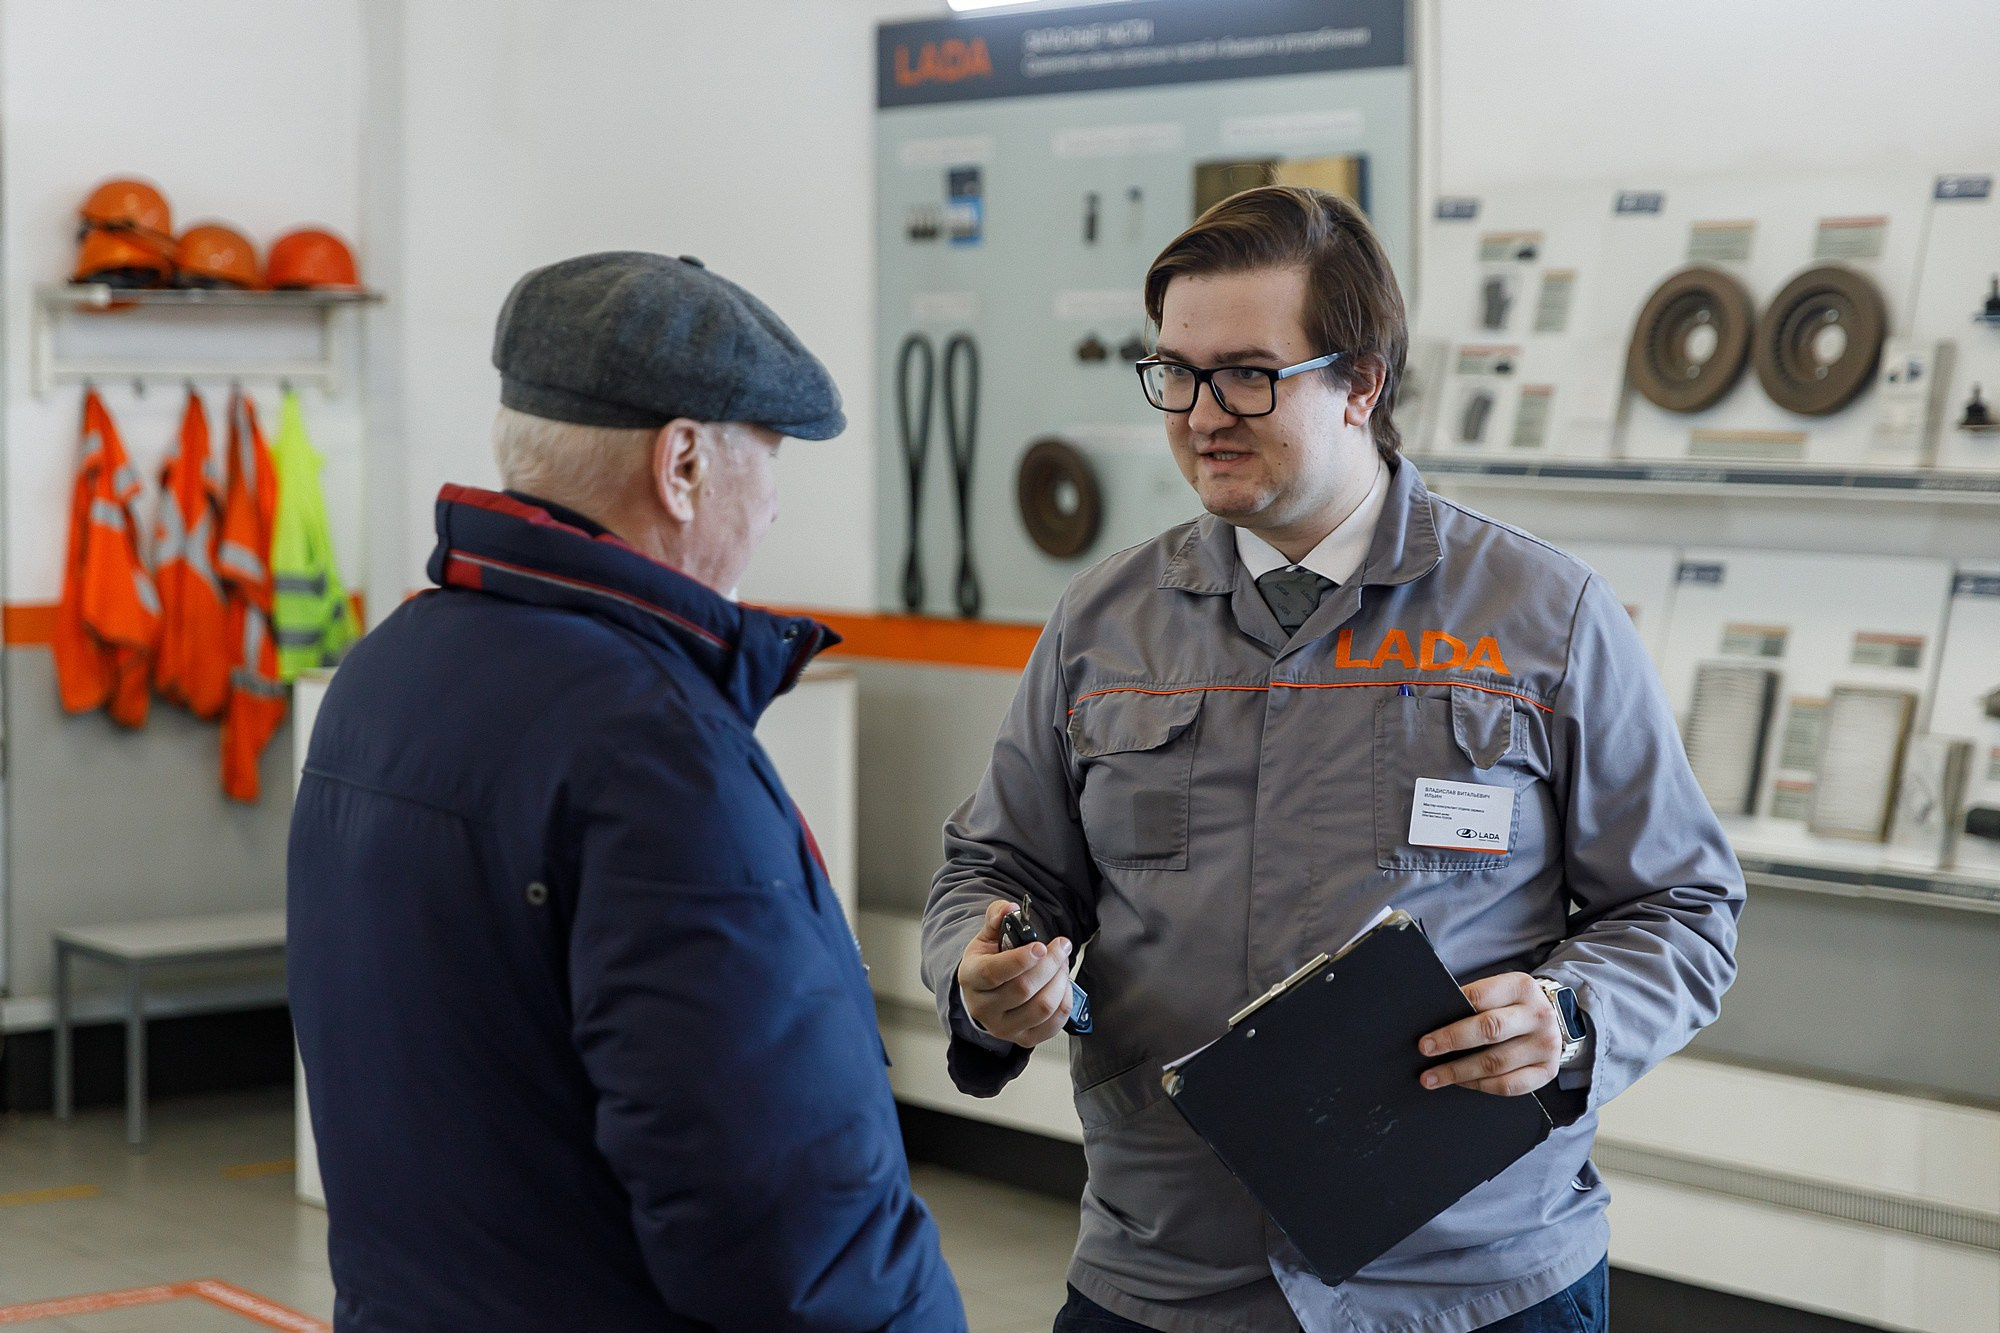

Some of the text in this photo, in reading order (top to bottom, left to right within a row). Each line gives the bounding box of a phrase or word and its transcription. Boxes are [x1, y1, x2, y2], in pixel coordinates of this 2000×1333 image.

[894, 37, 993, 87] LADA
[1335, 628, 1511, 676] LADA
[1425, 787, 1490, 799] ВЛАДИСЛАВ ВИТАЛЬЕВИЧ
[1479, 832, 1499, 840] LADA
